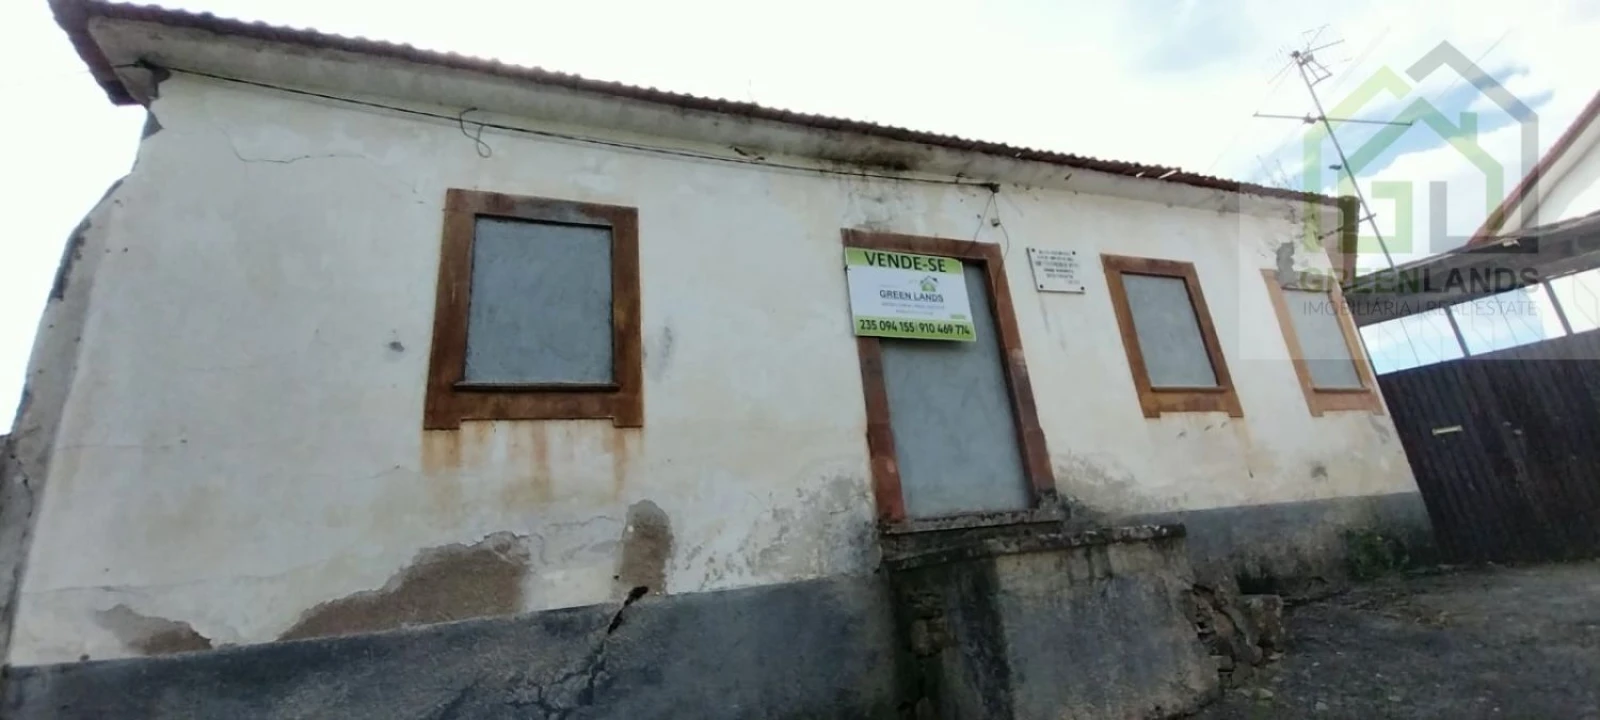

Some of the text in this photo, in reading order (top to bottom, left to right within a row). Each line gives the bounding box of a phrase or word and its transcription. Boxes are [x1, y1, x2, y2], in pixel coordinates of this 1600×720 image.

[864, 251, 947, 273] VENDE-SE
[879, 289, 944, 303] GREEN LANDS
[860, 319, 971, 335] 235 094 155 910 469 774
